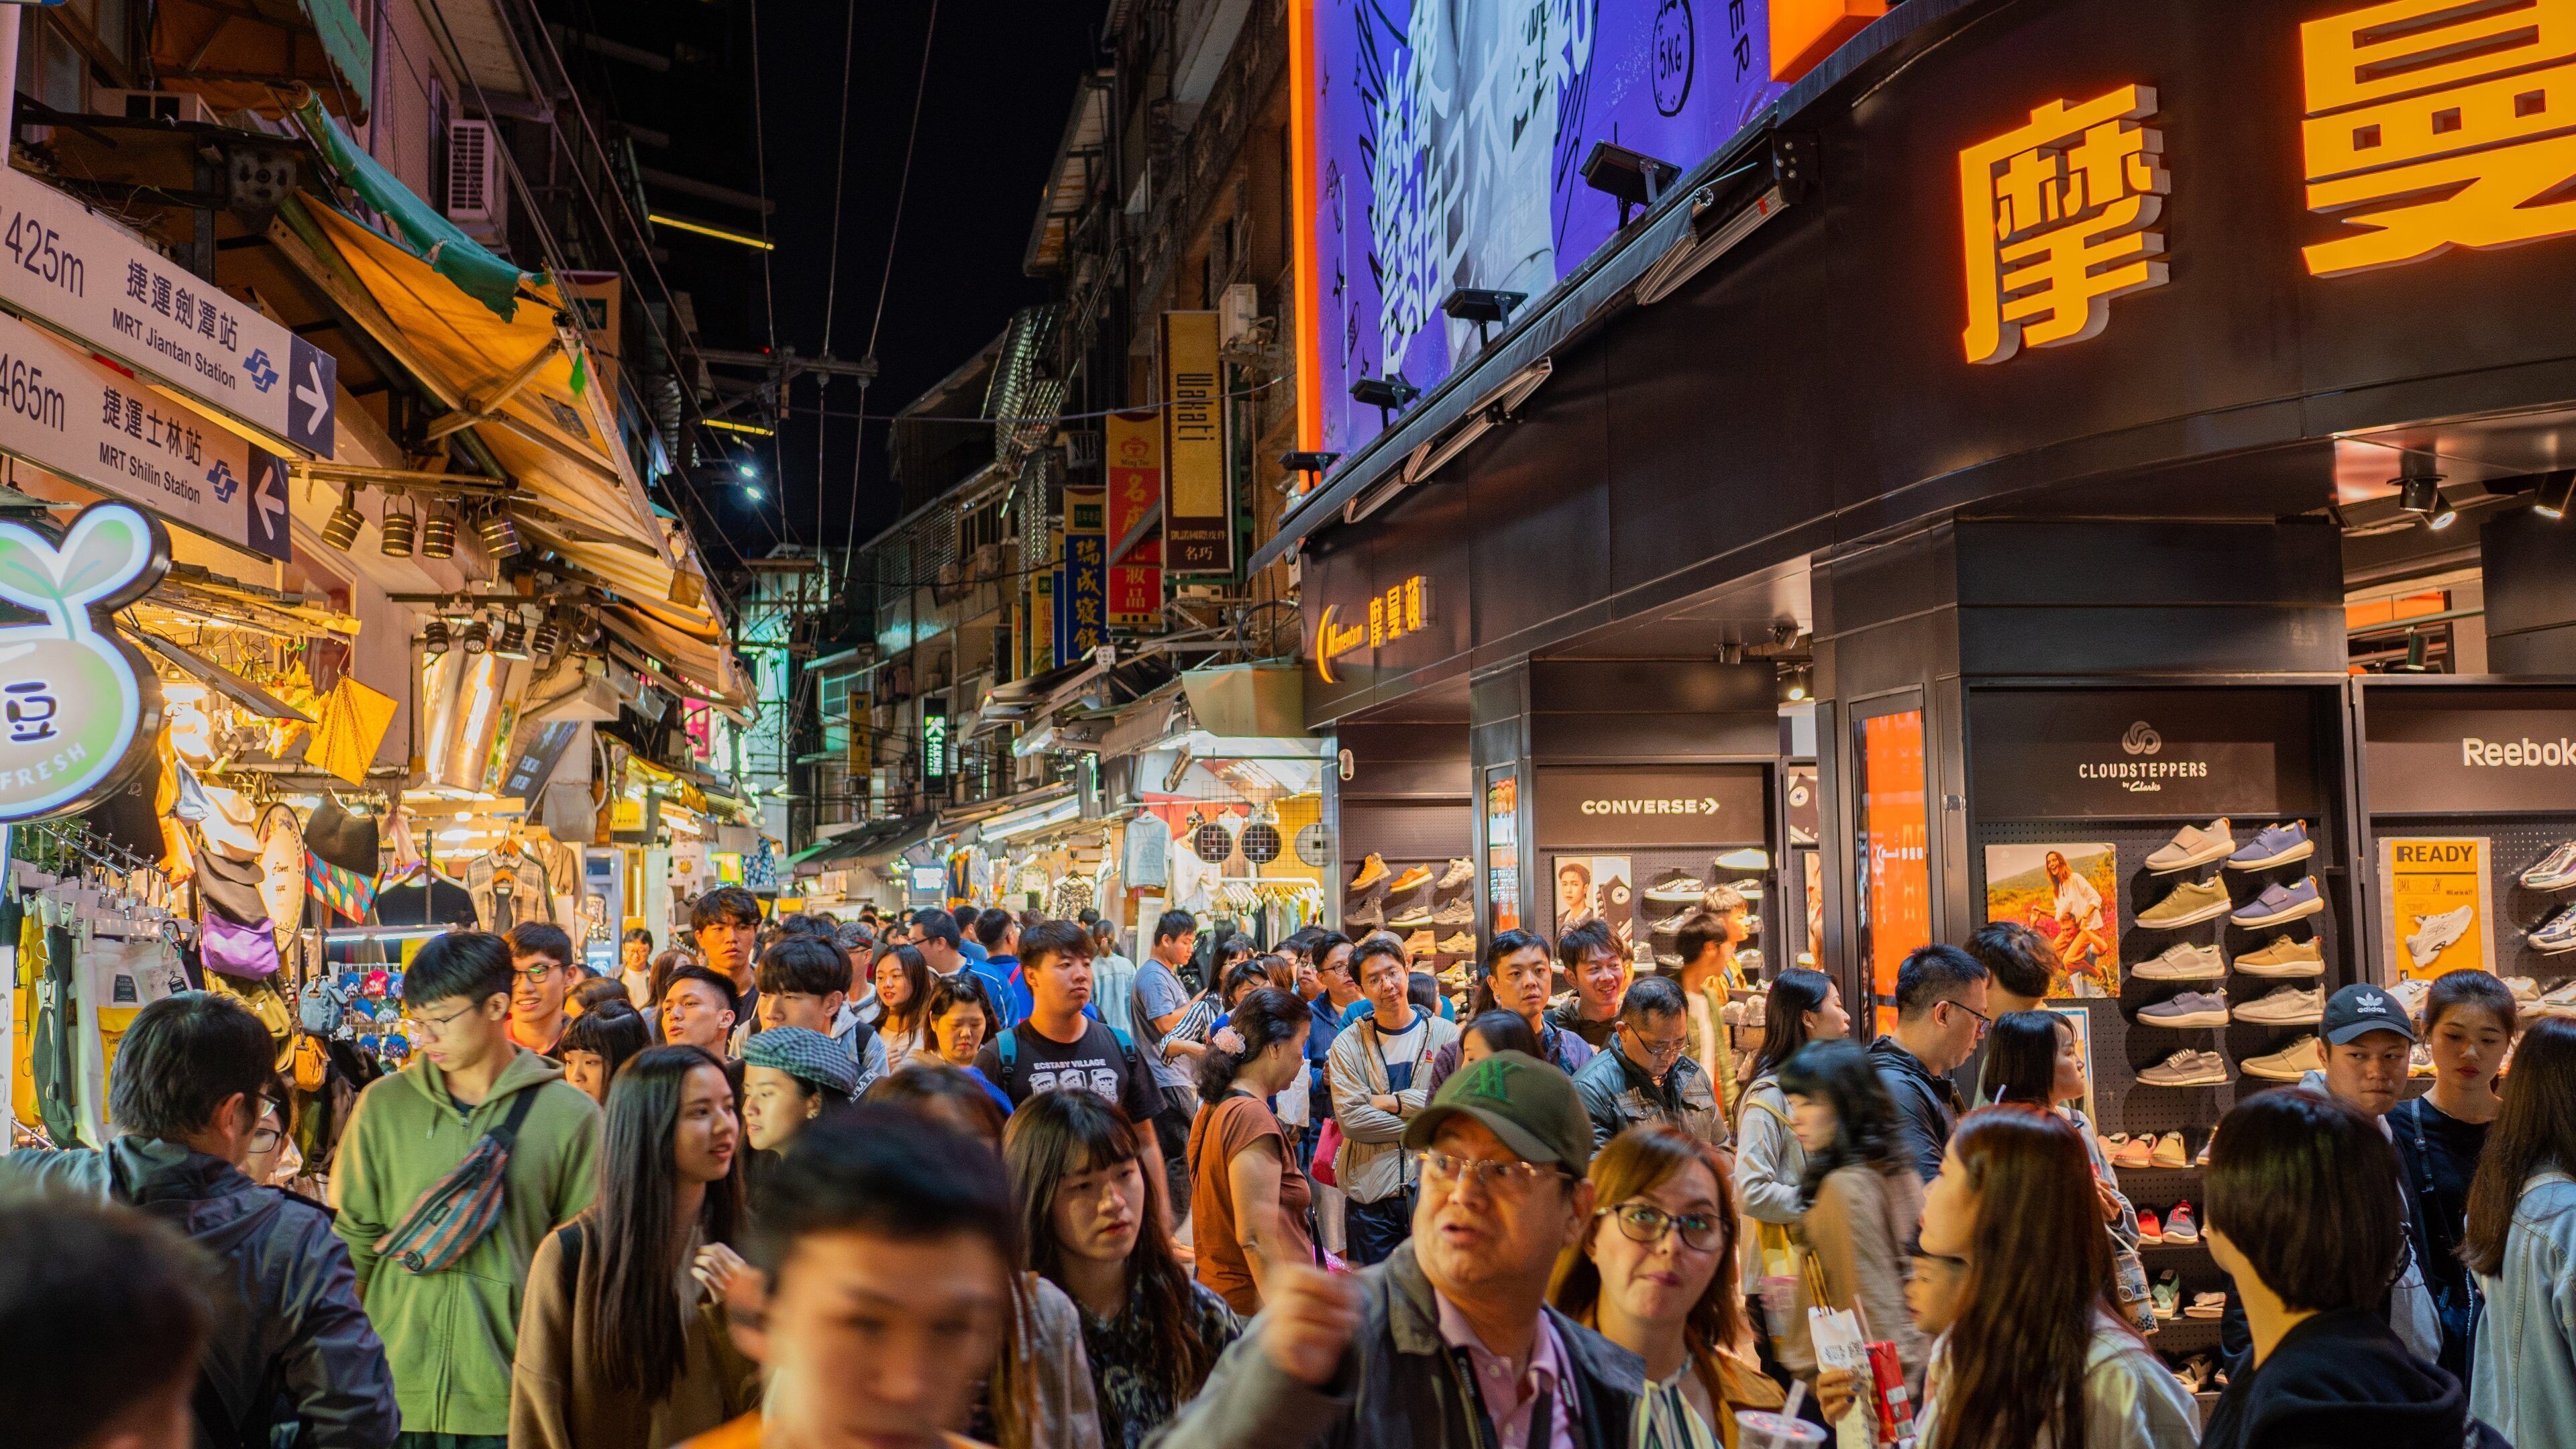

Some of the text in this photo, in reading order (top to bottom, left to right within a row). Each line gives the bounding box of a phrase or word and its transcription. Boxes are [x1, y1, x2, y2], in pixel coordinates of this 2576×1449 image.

[1660, 34, 1682, 80] 5KG
[5, 212, 83, 298] 425m
[126, 258, 238, 353] 捷運劍潭站
[113, 308, 236, 390] MRT Jiantan Station
[0, 354, 65, 432] 465m
[103, 386, 201, 467] 捷運士林站
[99, 442, 201, 505] MRT Shilin Station
[1369, 576, 1421, 648] 摩曼頓
[0, 742, 87, 790] FRESH
[2080, 762, 2207, 778] CLOUDSTEPPERS
[2463, 738, 2576, 766] Reebok
[1581, 800, 1697, 814] CONVERSE
[2130, 781, 2161, 792] Clarks
[2397, 846, 2473, 862] READY
[2398, 878, 2410, 892] DMX
[1034, 1059, 1106, 1070] ECSTASY VILLAGE
